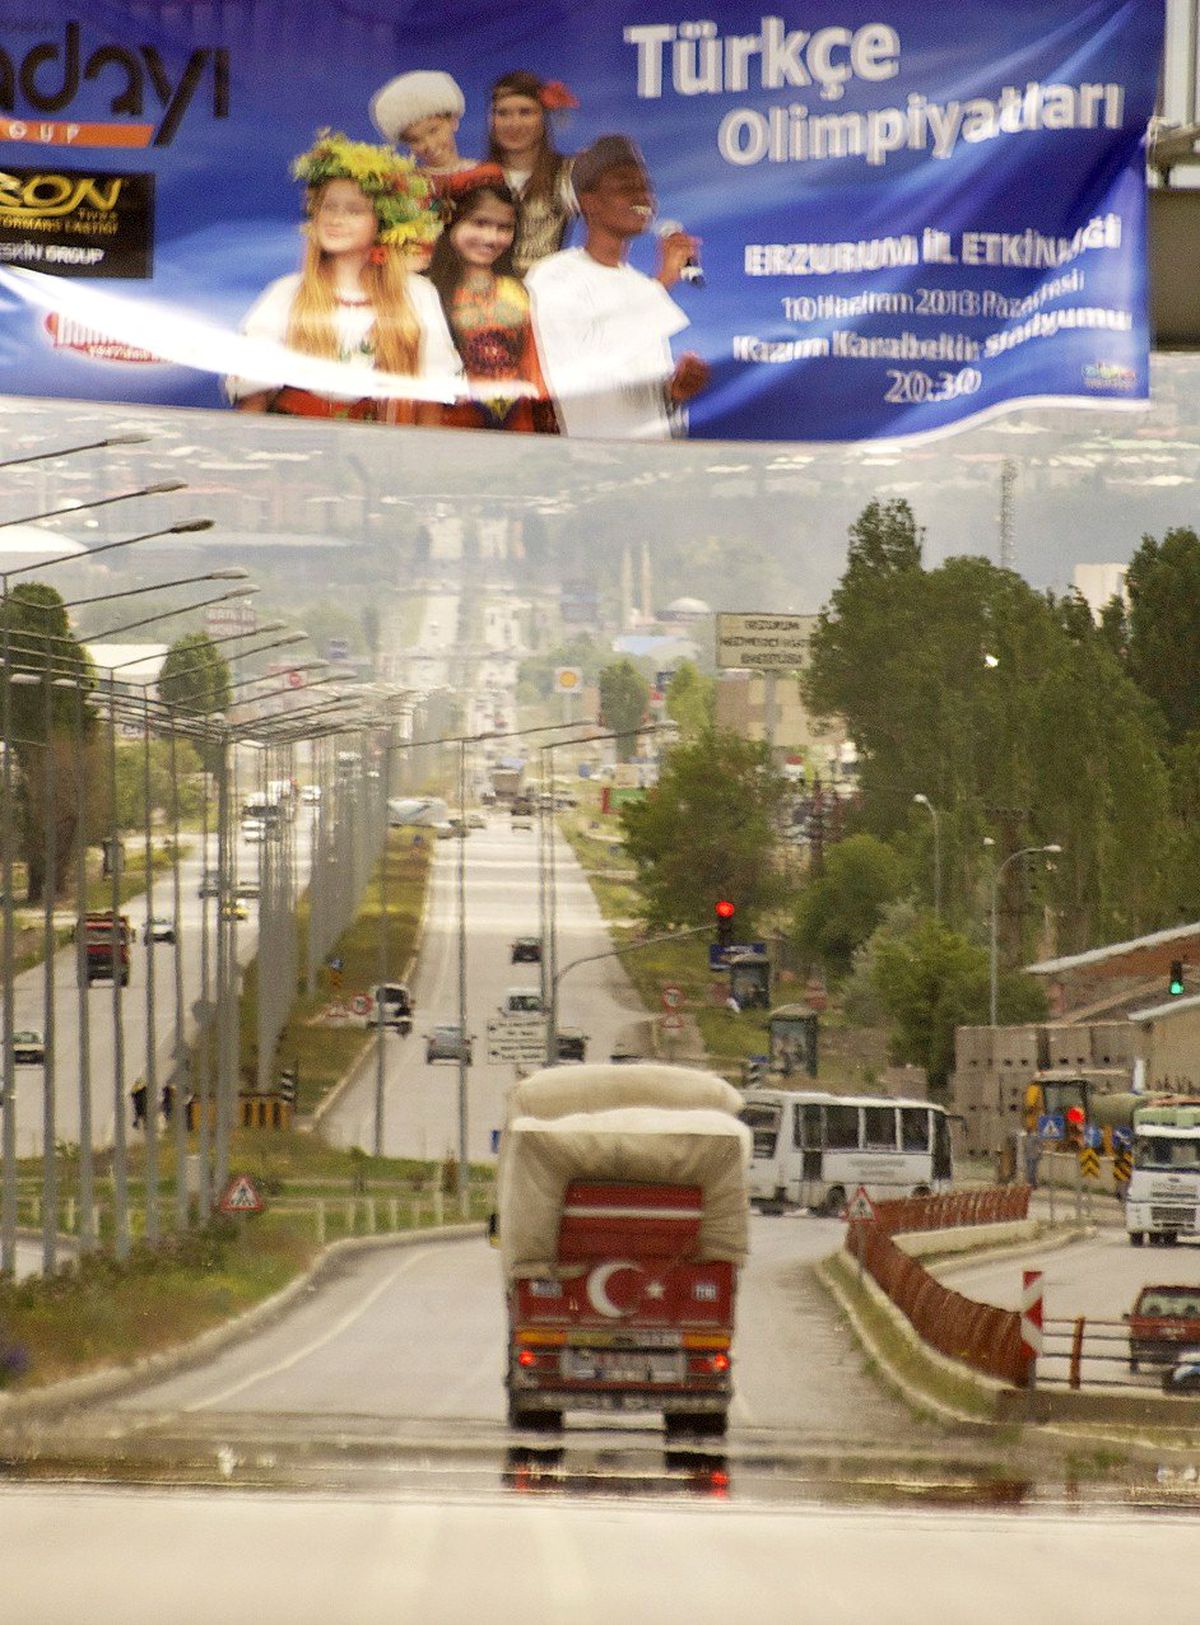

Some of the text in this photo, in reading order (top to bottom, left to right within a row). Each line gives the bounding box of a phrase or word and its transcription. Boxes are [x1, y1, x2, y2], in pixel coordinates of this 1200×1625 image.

[623, 16, 900, 99] Türkçe
[718, 83, 1125, 165] Olimpiyatları
[45, 244, 105, 266] GROUP
[744, 234, 919, 277] ERZURUM
[922, 226, 959, 265] İL
[781, 296, 816, 322] 10
[817, 291, 914, 321] Haziran
[915, 288, 981, 318] 2013
